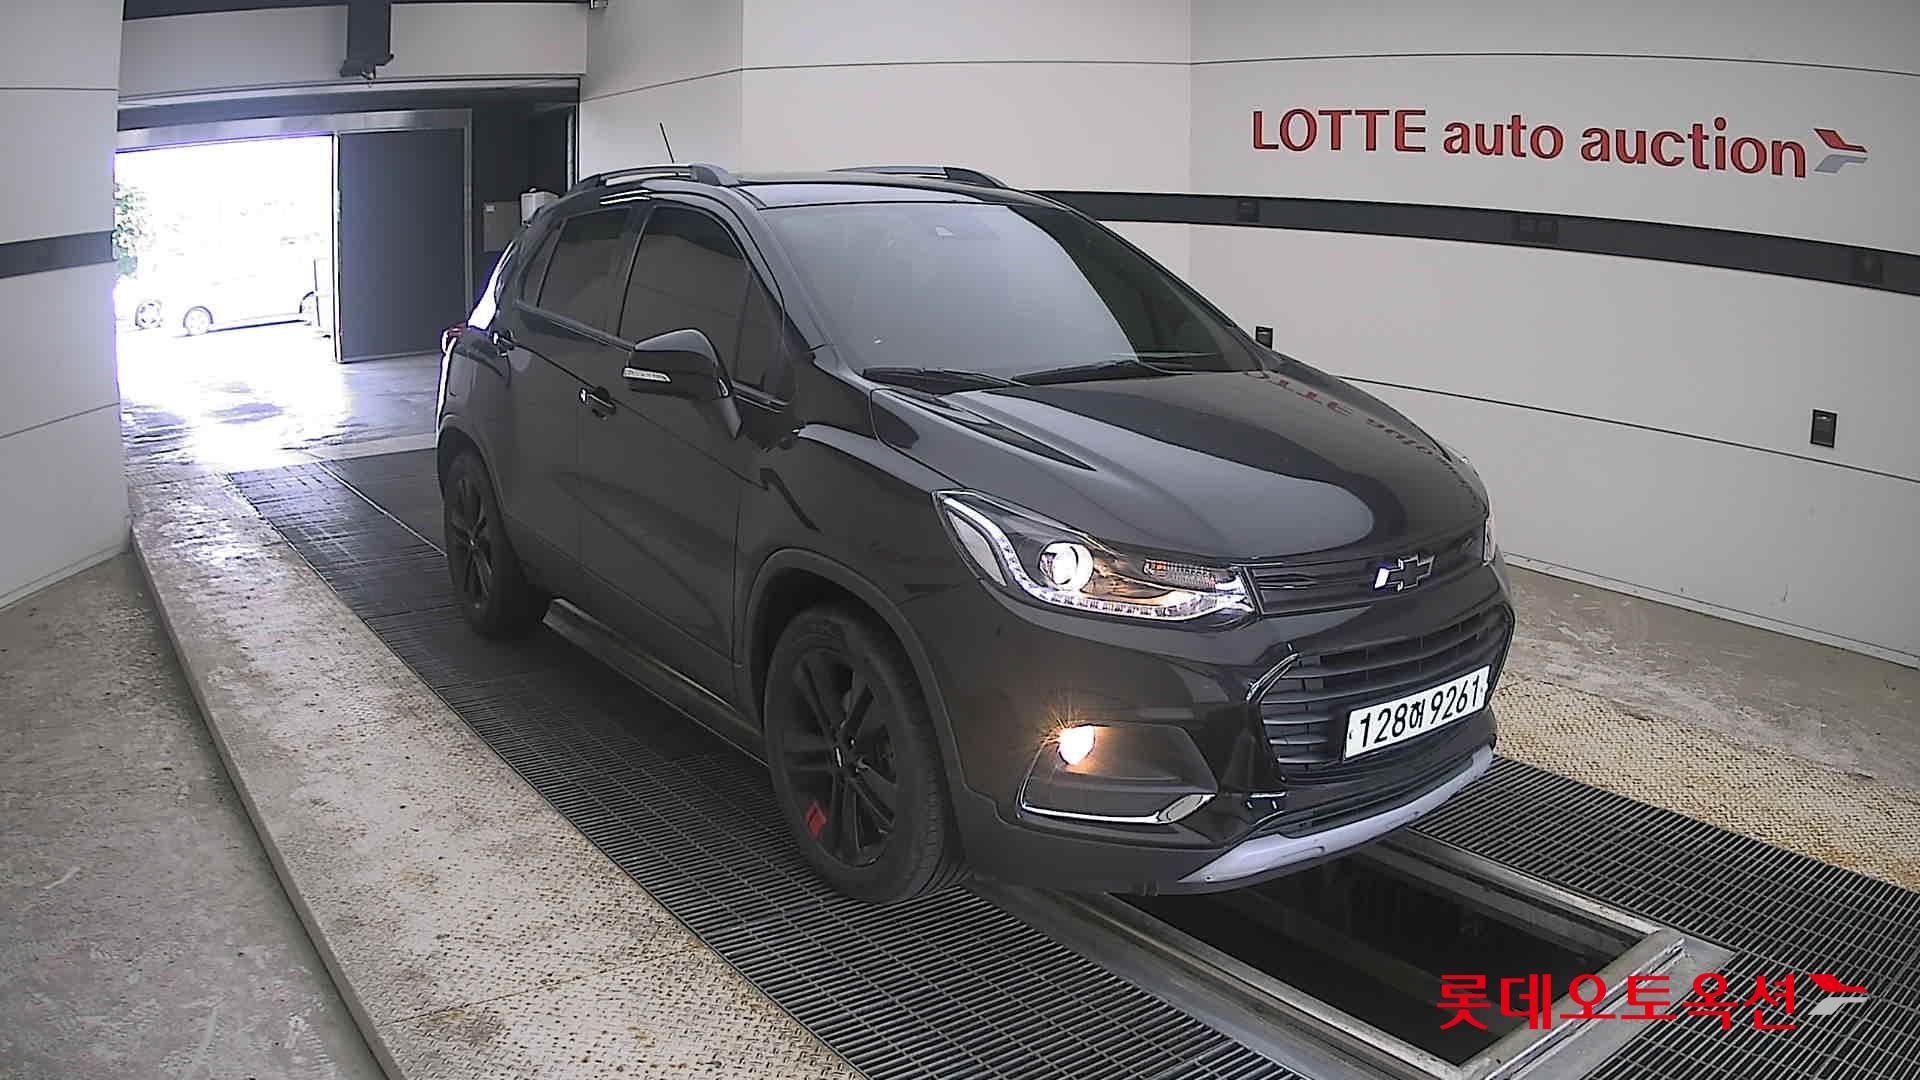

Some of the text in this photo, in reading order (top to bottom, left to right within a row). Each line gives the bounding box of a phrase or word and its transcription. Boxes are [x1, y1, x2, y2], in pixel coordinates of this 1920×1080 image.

[1252, 108, 1807, 178] LOTTE auto auction
